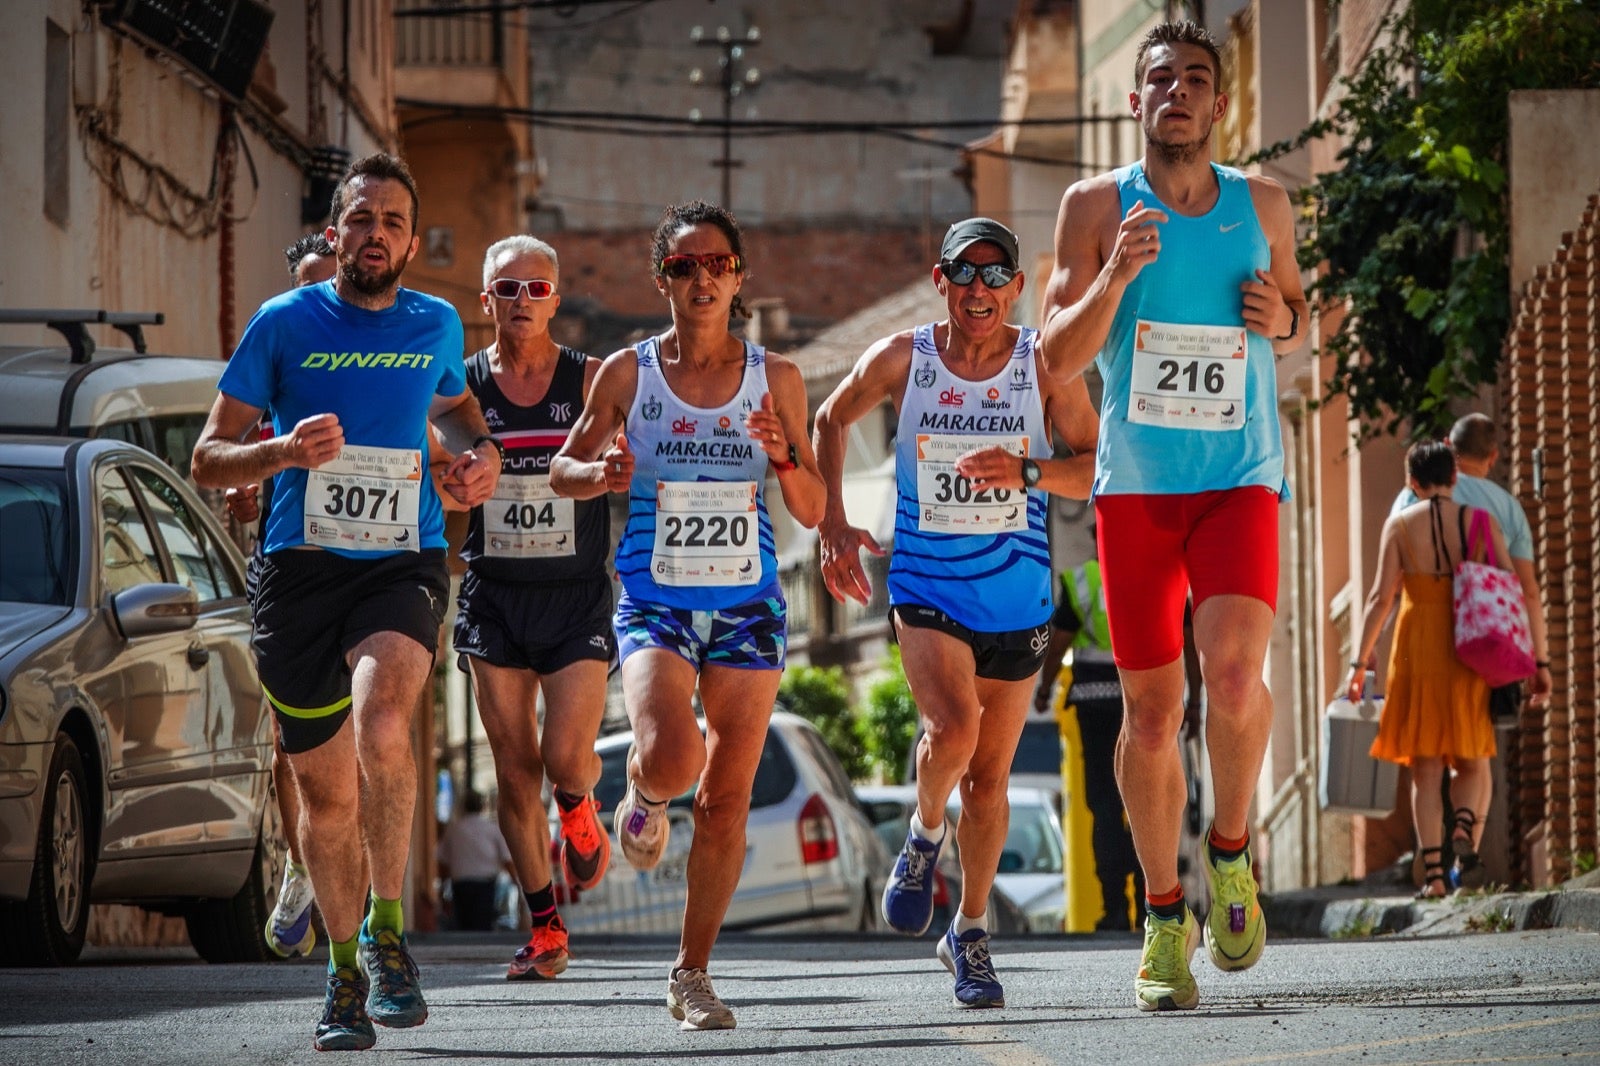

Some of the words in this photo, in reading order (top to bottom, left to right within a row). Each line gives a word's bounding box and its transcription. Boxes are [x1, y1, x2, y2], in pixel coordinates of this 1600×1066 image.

[300, 352, 434, 371] DYNAFIT
[1157, 360, 1225, 394] 216
[920, 412, 1025, 432] MARACENA
[656, 441, 753, 460] MARACENA
[503, 453, 550, 469] rund
[700, 459, 742, 467] ATLETISMO
[324, 484, 400, 521] 3071
[504, 502, 555, 529] 404
[665, 516, 748, 547] 2220
